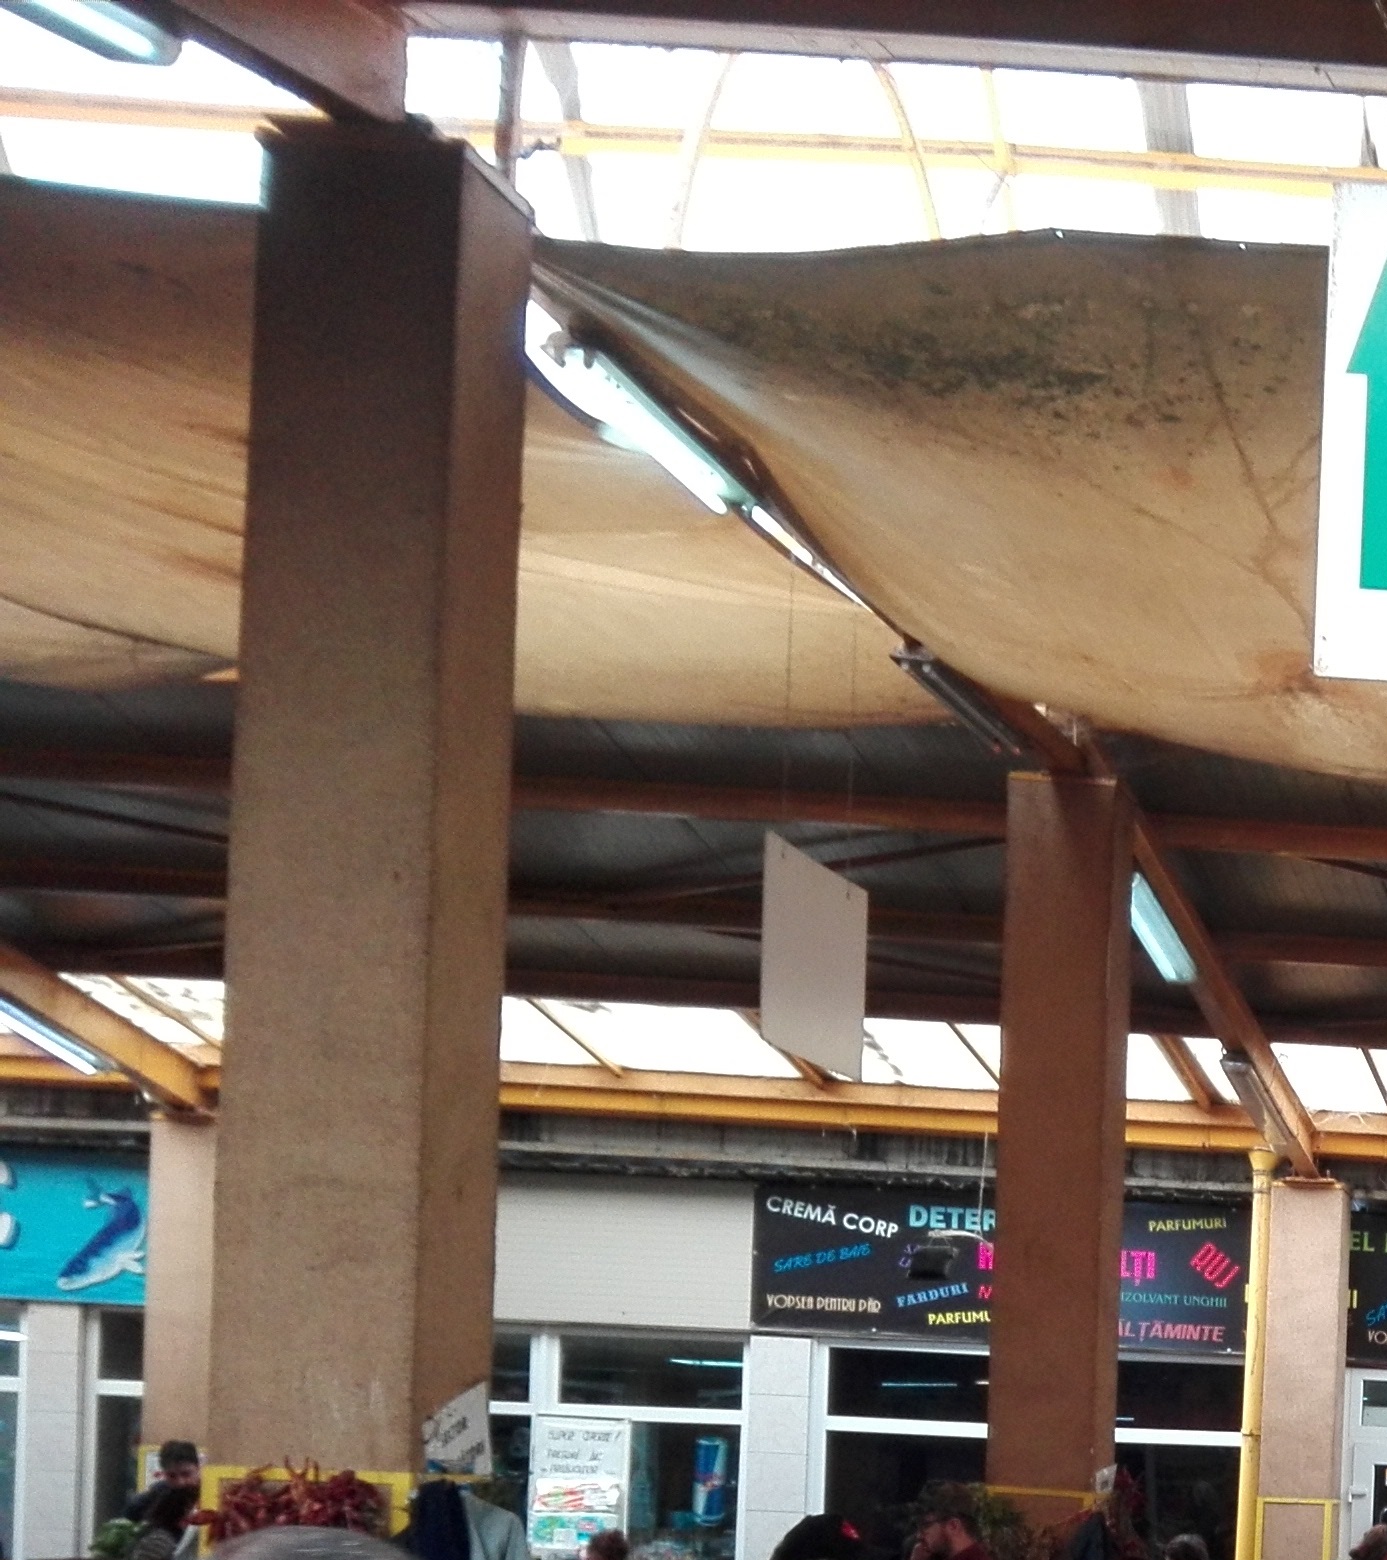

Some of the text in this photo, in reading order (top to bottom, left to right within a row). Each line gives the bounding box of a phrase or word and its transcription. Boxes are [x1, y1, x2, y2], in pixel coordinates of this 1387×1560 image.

[766, 1196, 899, 1239] CREMĂ CORP
[1147, 1217, 1227, 1233] PARFUMURI
[815, 1251, 835, 1264] DE
[1190, 1241, 1241, 1289] RUJ
[766, 1293, 814, 1310] VOPSEA
[815, 1296, 856, 1313] PENTRU
[896, 1282, 969, 1309] FARDURI
[1183, 1294, 1227, 1309] UNGHII
